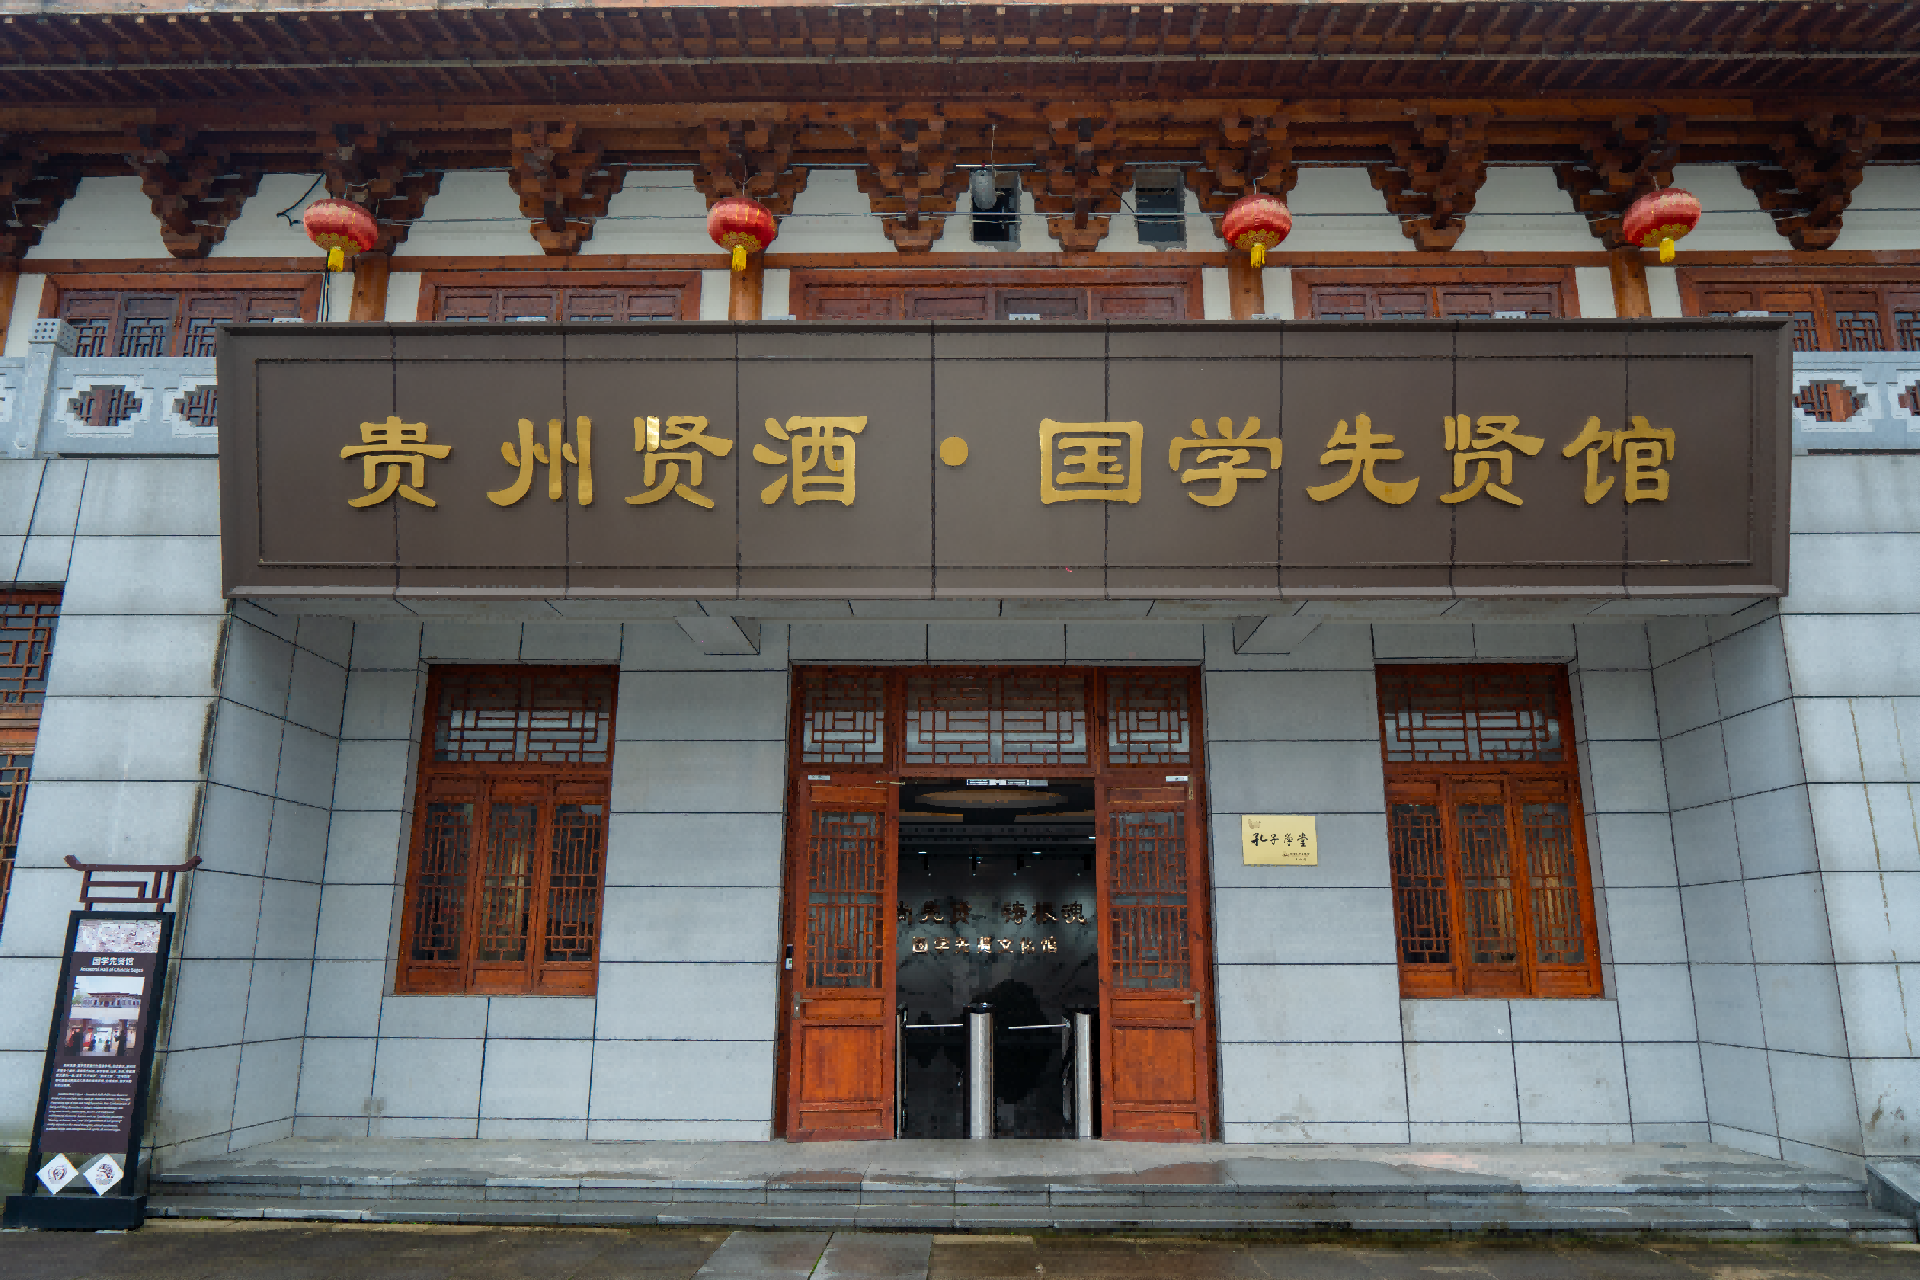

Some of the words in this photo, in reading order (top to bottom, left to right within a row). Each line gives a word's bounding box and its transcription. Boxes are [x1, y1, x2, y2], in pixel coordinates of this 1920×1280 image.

[92, 956, 135, 966] 国学先贤馆
